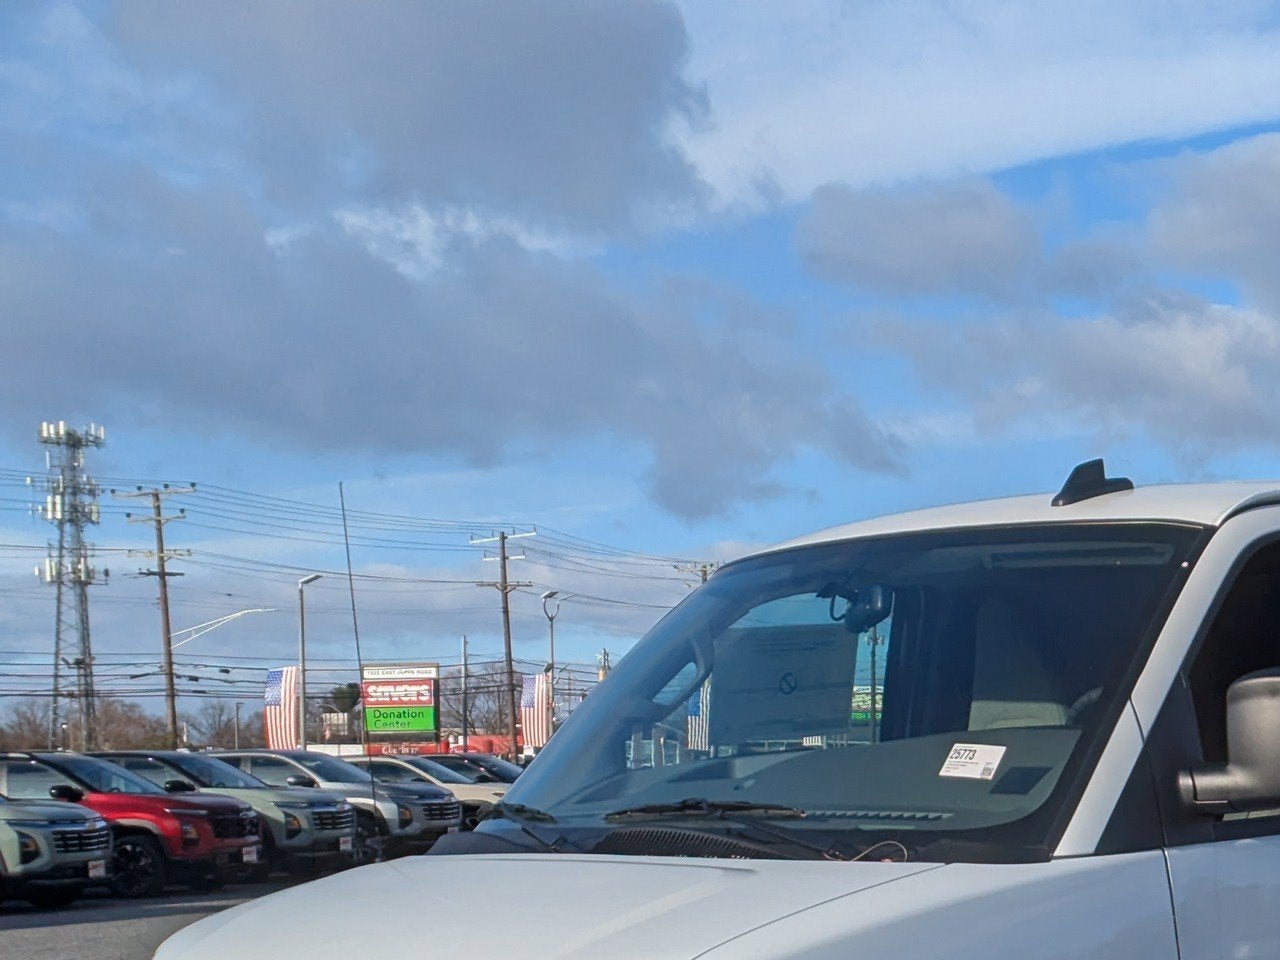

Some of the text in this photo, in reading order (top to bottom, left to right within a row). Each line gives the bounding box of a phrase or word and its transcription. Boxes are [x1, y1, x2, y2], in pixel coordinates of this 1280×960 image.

[373, 708, 425, 719] Donation
[373, 719, 412, 729] Center
[949, 748, 977, 760] 25773
